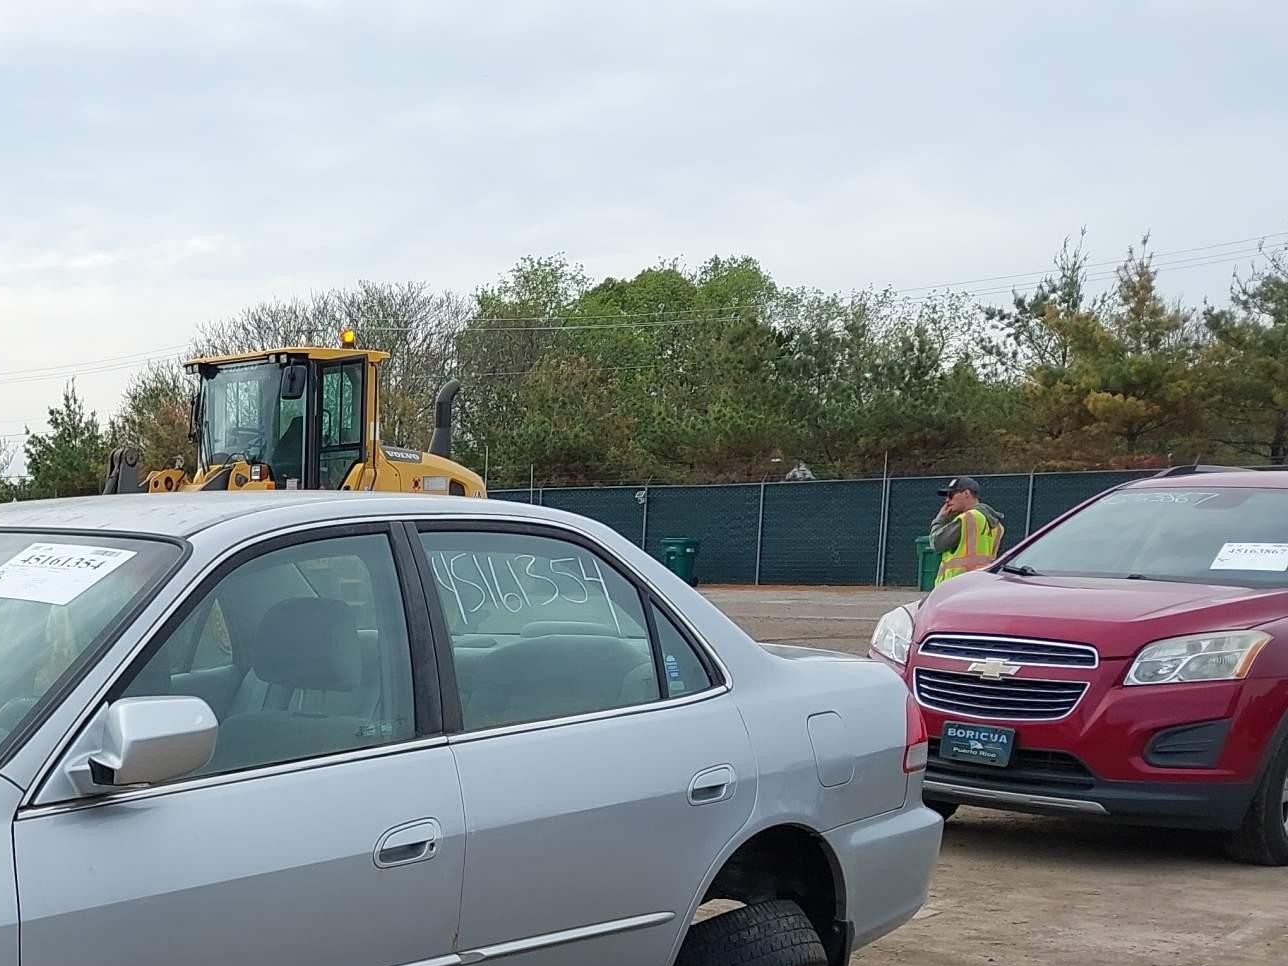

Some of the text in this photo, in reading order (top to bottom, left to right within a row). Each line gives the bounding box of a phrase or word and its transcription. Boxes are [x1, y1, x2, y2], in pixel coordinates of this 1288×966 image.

[385, 450, 420, 460] VOLVO
[20, 554, 106, 571] 45161354
[431, 552, 622, 636] 45161354
[947, 728, 1008, 744] BORICUA
[953, 746, 997, 758] Puerto Rico
